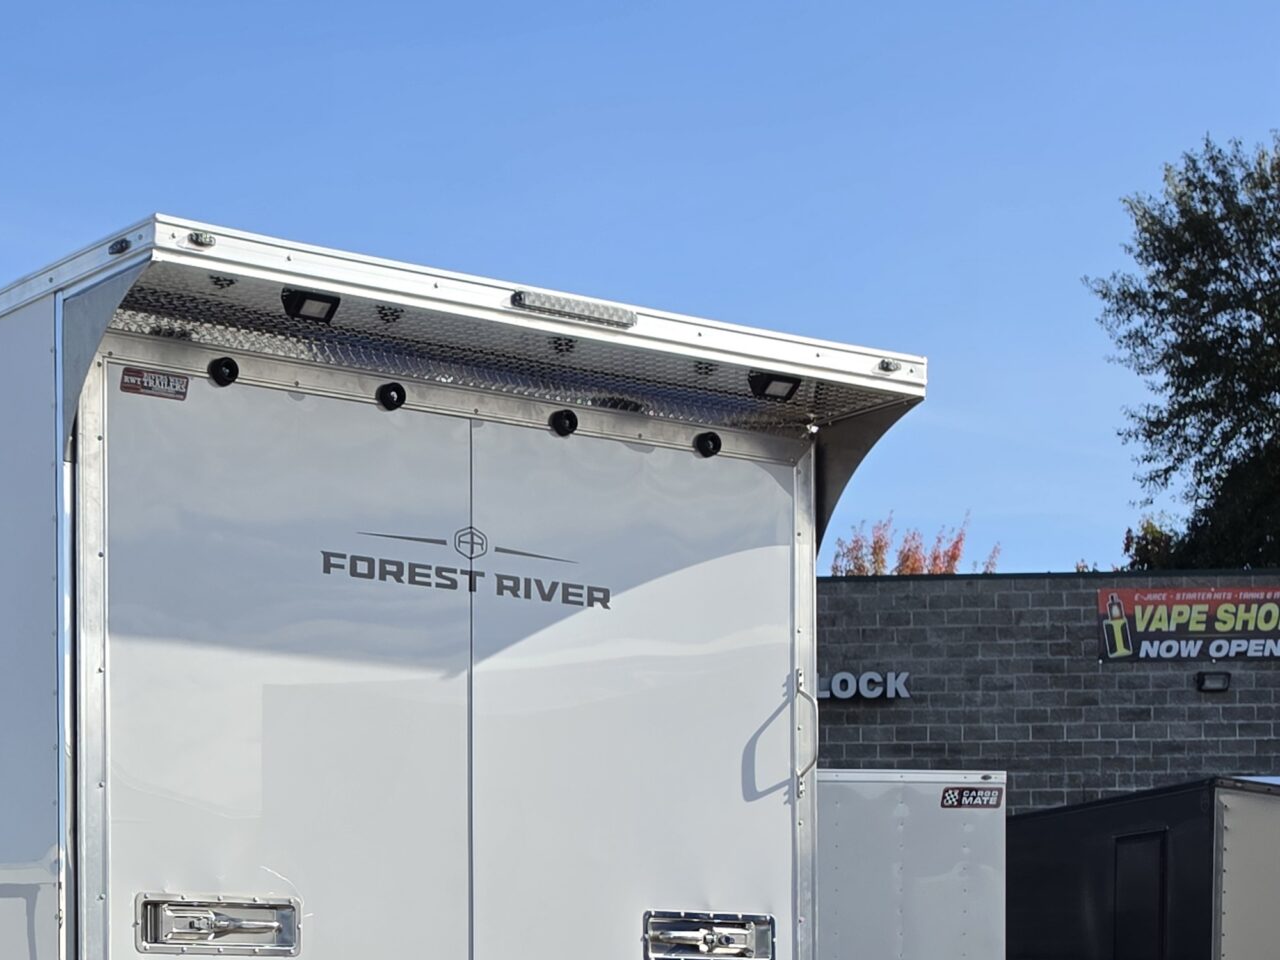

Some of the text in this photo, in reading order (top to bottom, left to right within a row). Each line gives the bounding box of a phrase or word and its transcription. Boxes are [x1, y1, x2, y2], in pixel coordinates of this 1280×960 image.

[321, 551, 611, 610] FOREST RIVER
[1135, 602, 1280, 632] VAPE SHO
[1139, 639, 1280, 658] NOW OPEN
[961, 796, 997, 805] MATE
